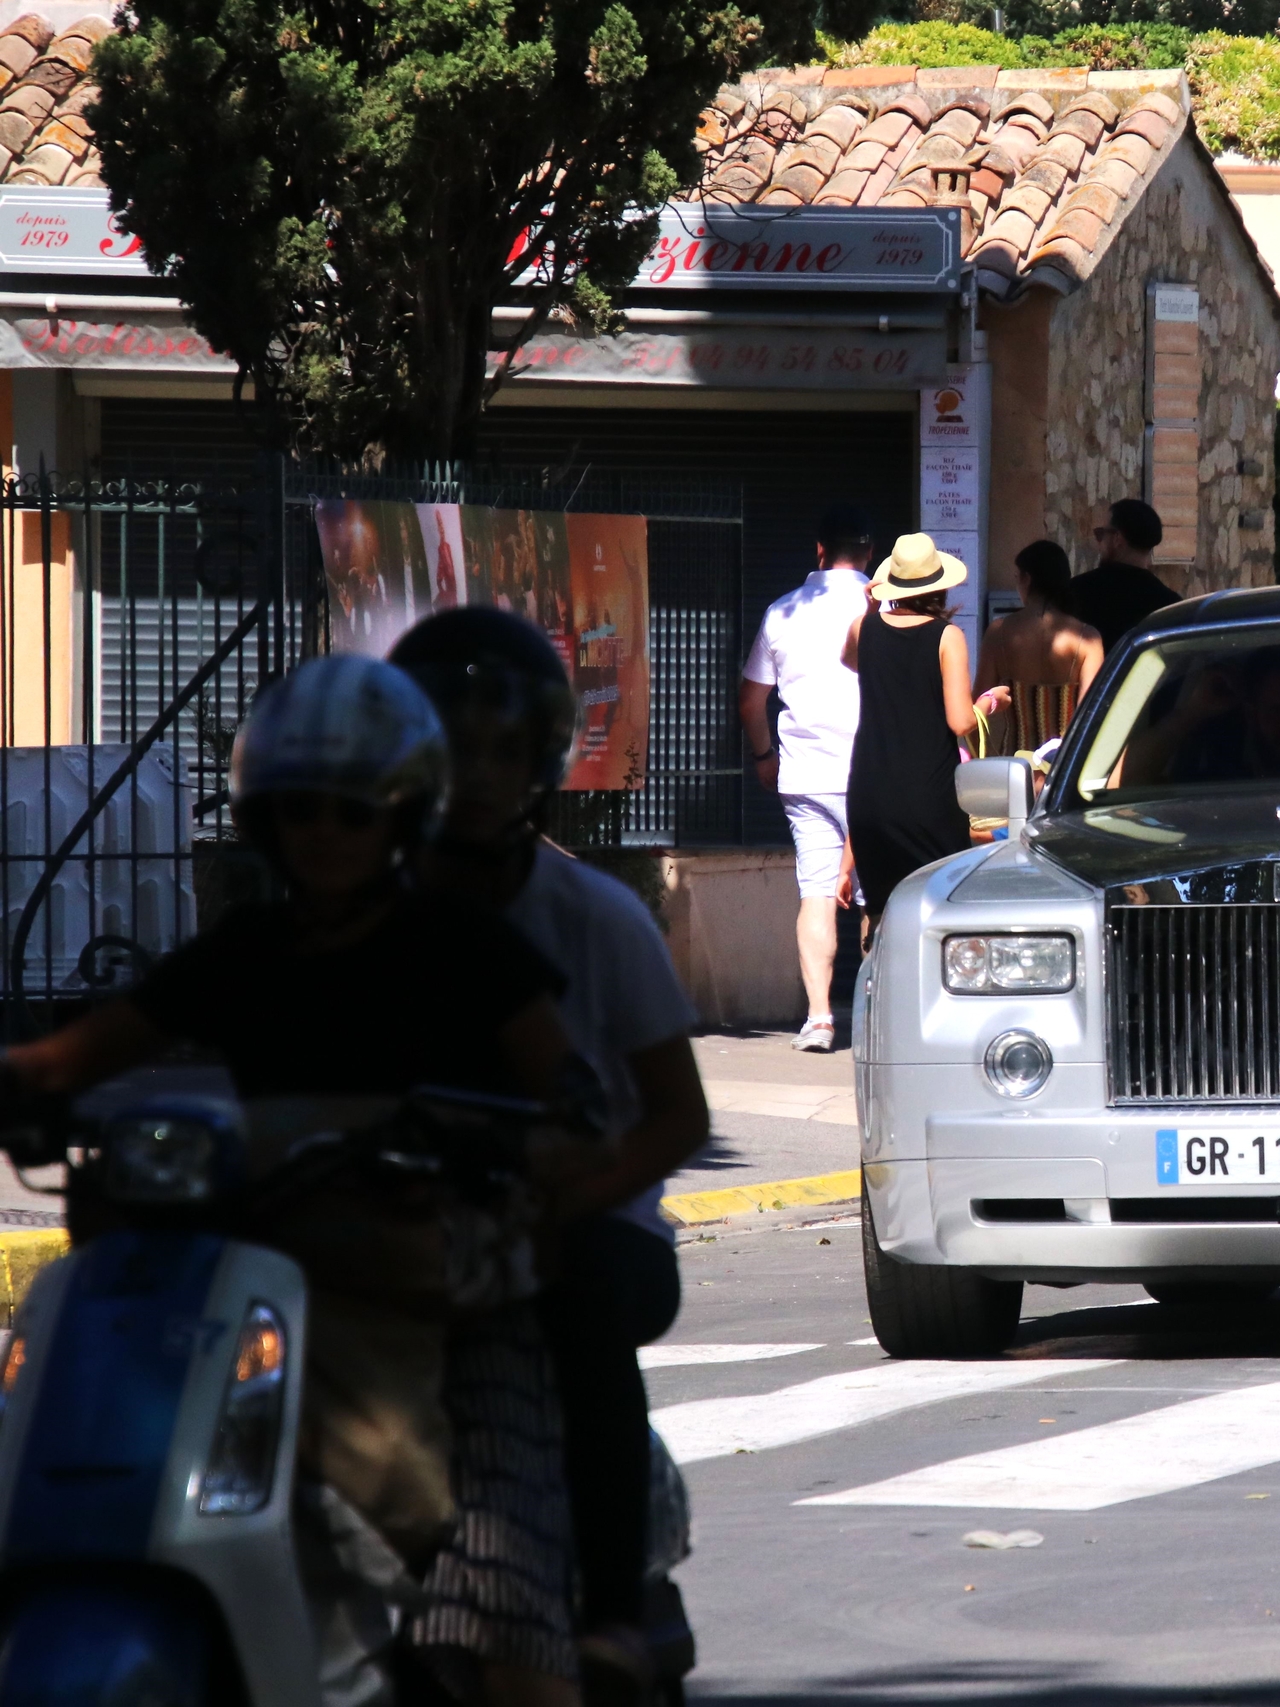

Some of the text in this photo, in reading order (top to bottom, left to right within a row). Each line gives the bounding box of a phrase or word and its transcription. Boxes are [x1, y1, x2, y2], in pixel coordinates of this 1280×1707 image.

[16, 211, 67, 228] depuis
[20, 230, 69, 248] 1979
[872, 230, 922, 246] depuis
[875, 248, 923, 266] 1979
[22, 318, 232, 356] Rôtisse
[828, 345, 863, 372] 85
[873, 345, 911, 374] 04
[1164, 1162, 1171, 1174] F
